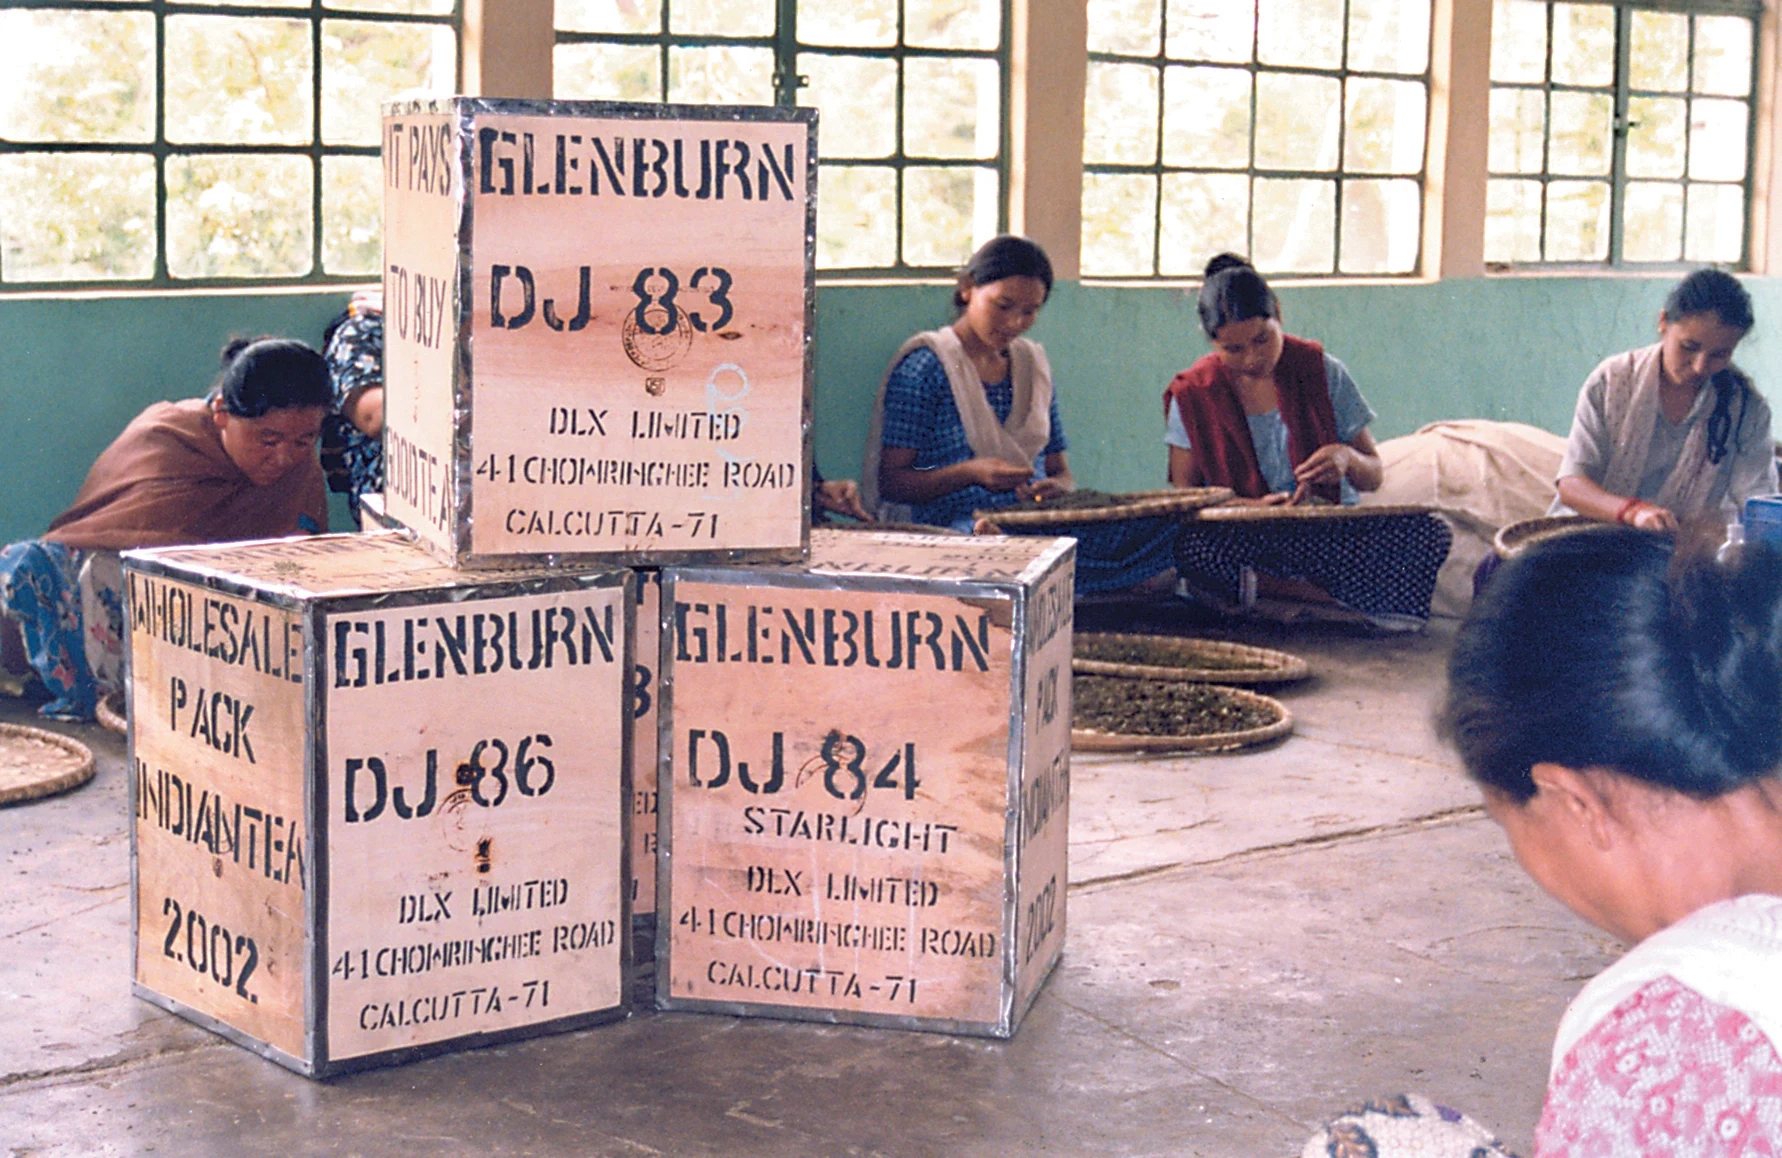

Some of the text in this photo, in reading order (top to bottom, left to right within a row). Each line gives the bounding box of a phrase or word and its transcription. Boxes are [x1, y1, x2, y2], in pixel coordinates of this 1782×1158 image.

[390, 123, 452, 196] IT PAYS
[479, 127, 794, 200] GLENBURN
[391, 265, 447, 349] TO BUY
[490, 265, 734, 335] DJ 83
[550, 408, 740, 440] DLX LIMITED
[724, 461, 795, 488] ROAD
[130, 573, 303, 683] WHOLESALE
[333, 605, 614, 688] GLENBURN
[675, 602, 990, 672] GLENBURN
[170, 676, 256, 764] PACK
[345, 749, 437, 823] DJ
[469, 733, 555, 808] 86
[689, 729, 920, 801] DJ 84
[744, 806, 957, 853] STARLIGHT
[400, 878, 568, 924] DLX LIMITED
[748, 866, 939, 907] DLX LIMITED
[554, 921, 615, 954] ROAD
[921, 928, 996, 958] ROAD
